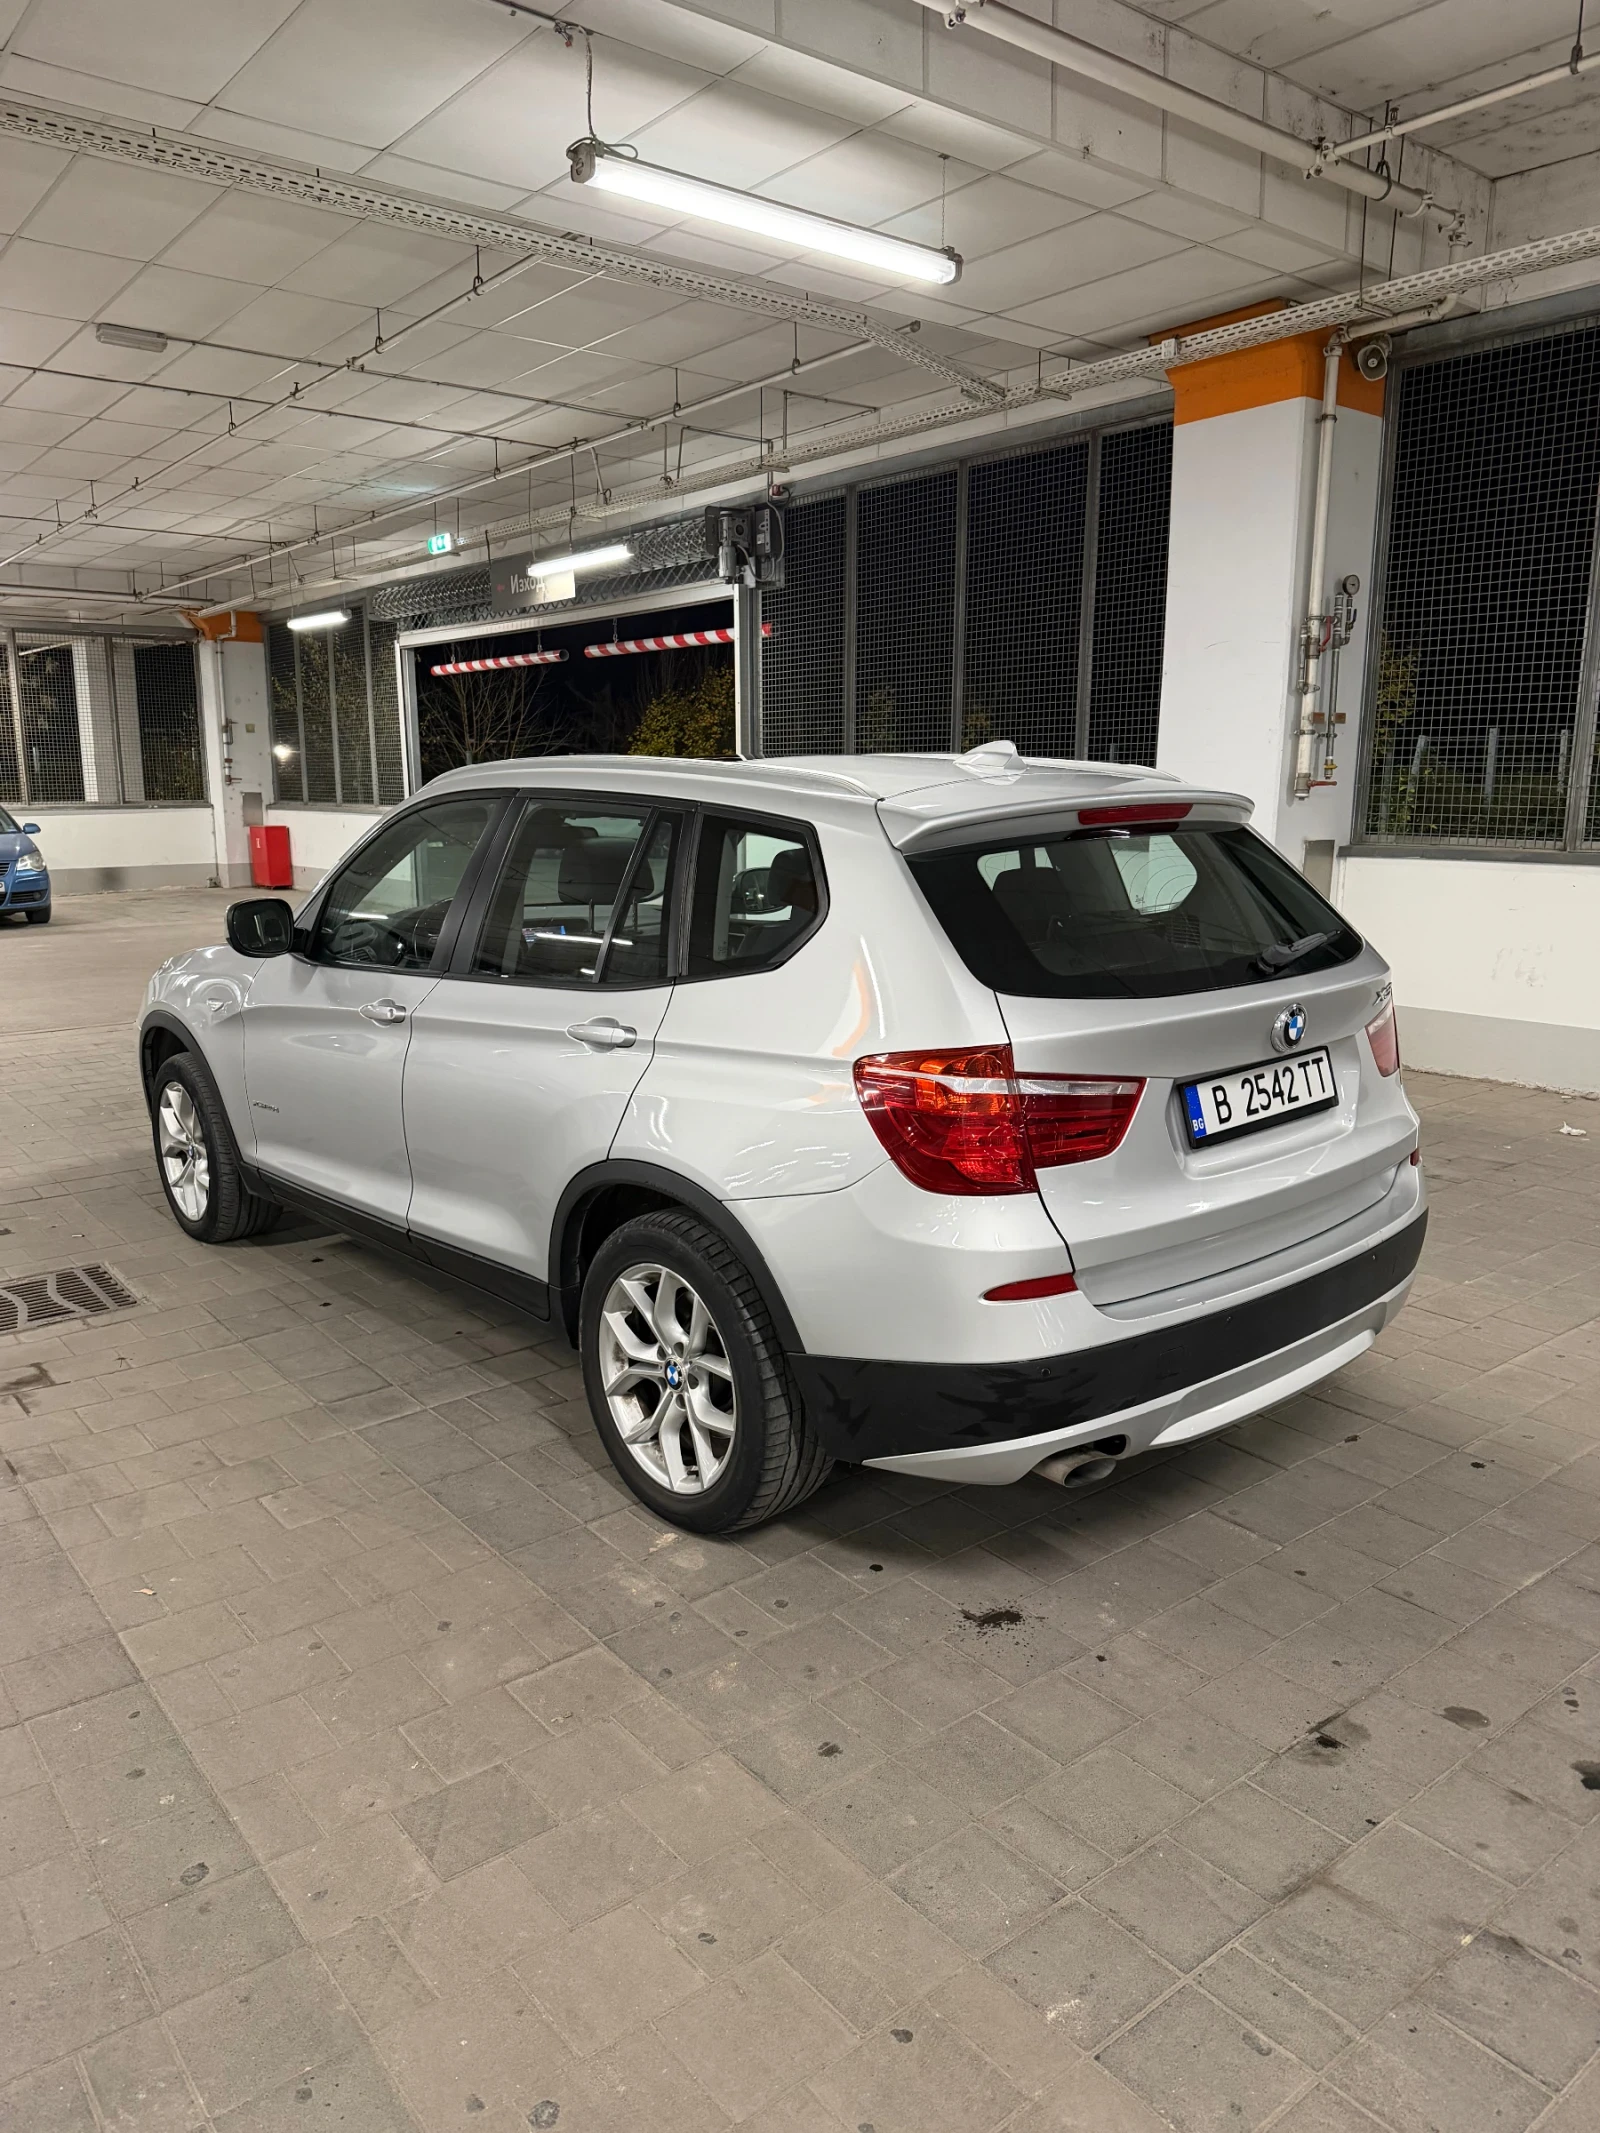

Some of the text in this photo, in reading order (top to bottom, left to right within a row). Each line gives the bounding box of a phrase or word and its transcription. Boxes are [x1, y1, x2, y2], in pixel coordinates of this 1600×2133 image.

[1212, 1056, 1325, 1125] B 2542 TT
[1192, 1117, 1205, 1132] BG
